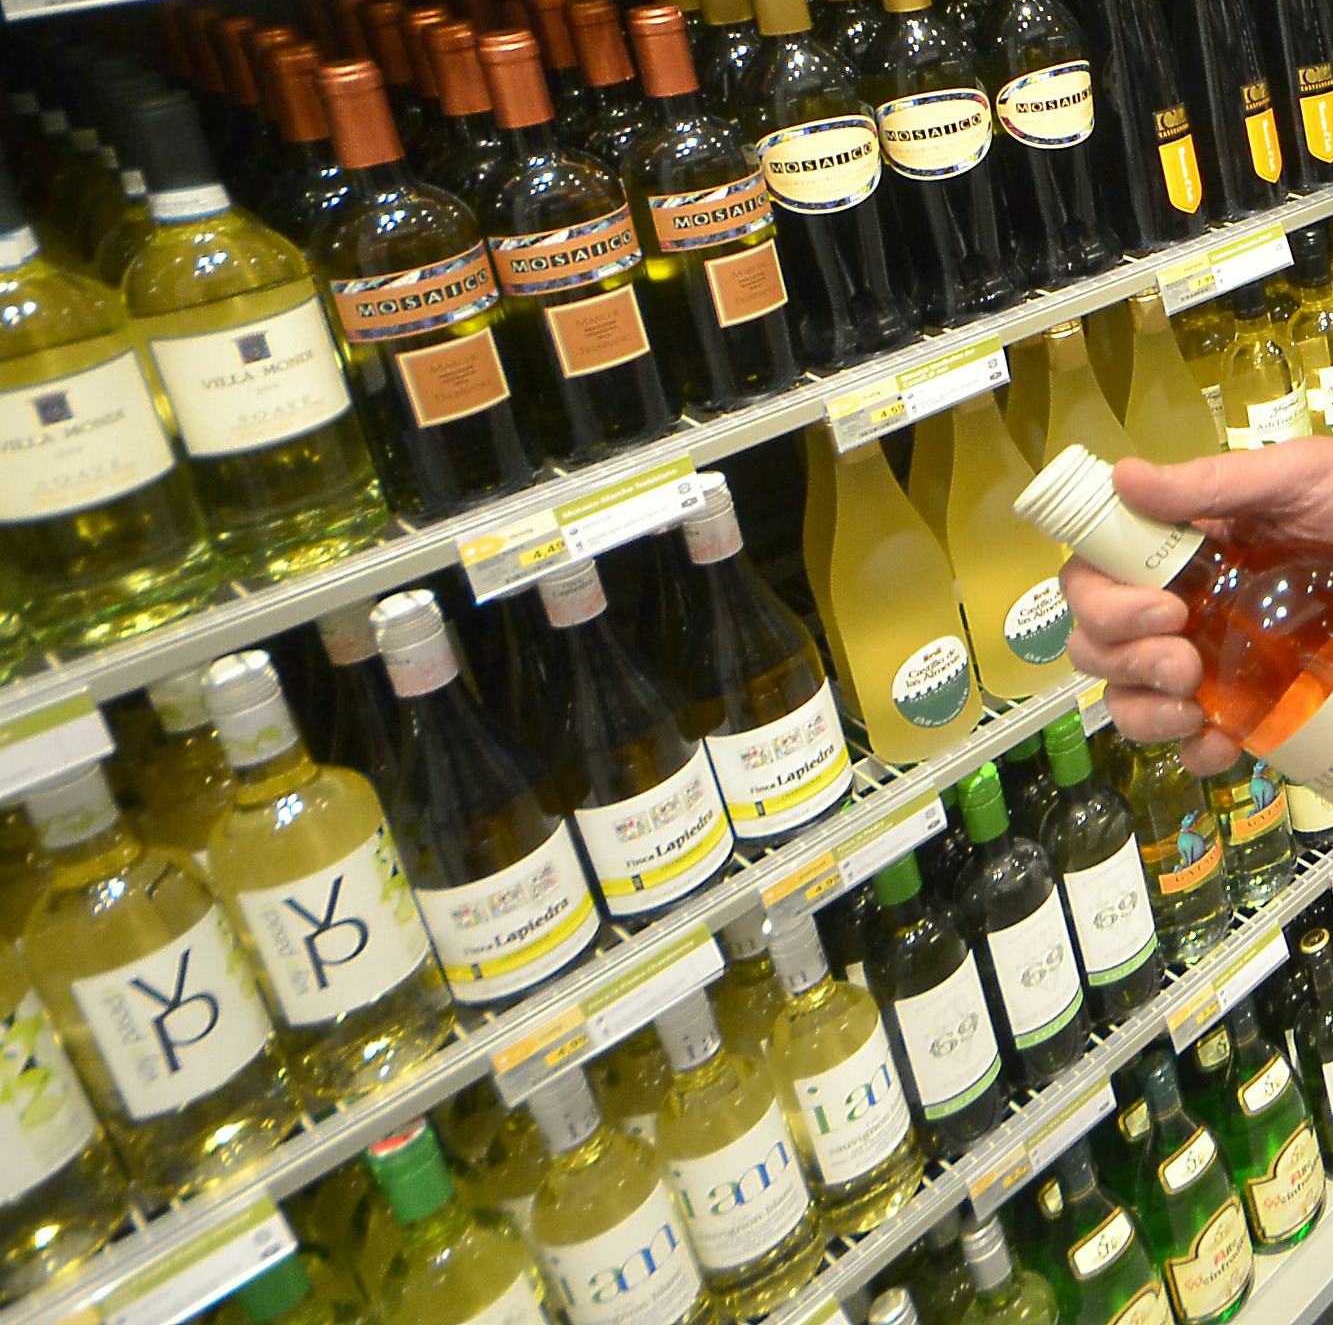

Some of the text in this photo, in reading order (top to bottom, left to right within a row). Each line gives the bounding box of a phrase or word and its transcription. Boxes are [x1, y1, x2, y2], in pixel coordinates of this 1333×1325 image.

[884, 113, 982, 142] MOSAICO
[769, 141, 873, 174] MOSAICO
[511, 230, 633, 274] MOSAICO
[357, 269, 489, 317] MOSAICO
[201, 350, 313, 390] VILLA MONDI
[64, 410, 124, 438] MONDI
[1019, 596, 1052, 617] Castillo
[905, 654, 961, 688] las Almenas
[908, 657, 945, 678] Castillo
[776, 742, 835, 787] Lapiedra
[655, 807, 713, 858] Lapiedra
[493, 897, 569, 947] Lapiedra
[1094, 890, 1138, 930] 69
[1020, 943, 1064, 988] 69
[930, 1011, 979, 1058] 69
